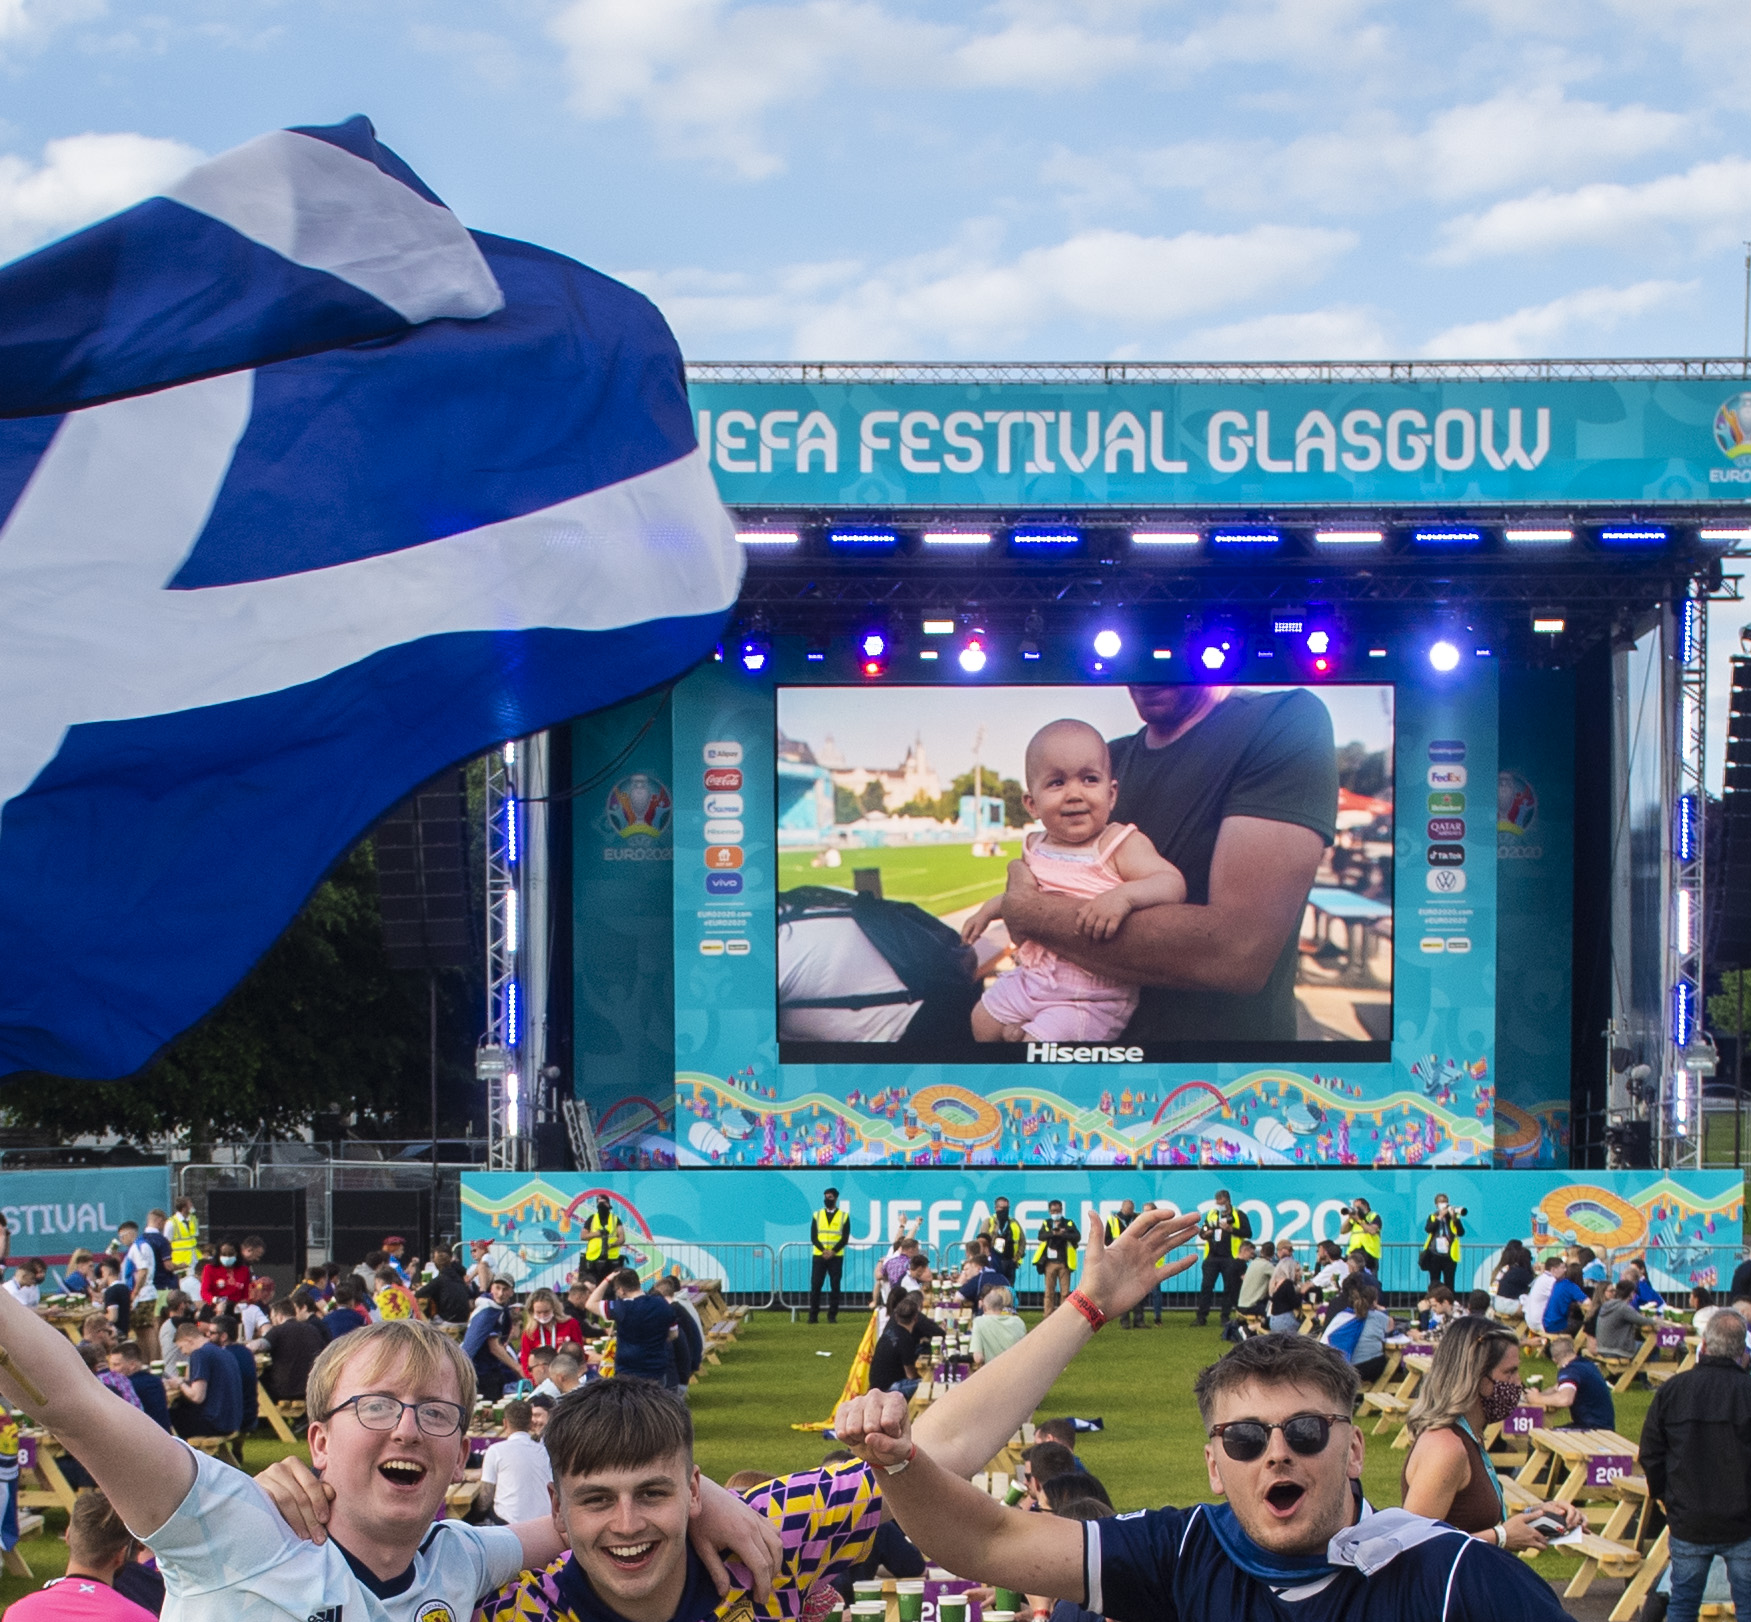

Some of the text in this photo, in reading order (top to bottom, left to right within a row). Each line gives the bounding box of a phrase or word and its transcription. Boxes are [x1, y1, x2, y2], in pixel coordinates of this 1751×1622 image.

[698, 407, 1550, 474] EFA FESTIVAL GLASGOW
[1431, 772, 1461, 783] FedEx
[1431, 822, 1462, 832] QATAR
[712, 878, 737, 887] vivo
[1026, 1042, 1144, 1063] Hisense
[1513, 1417, 1534, 1432] 181
